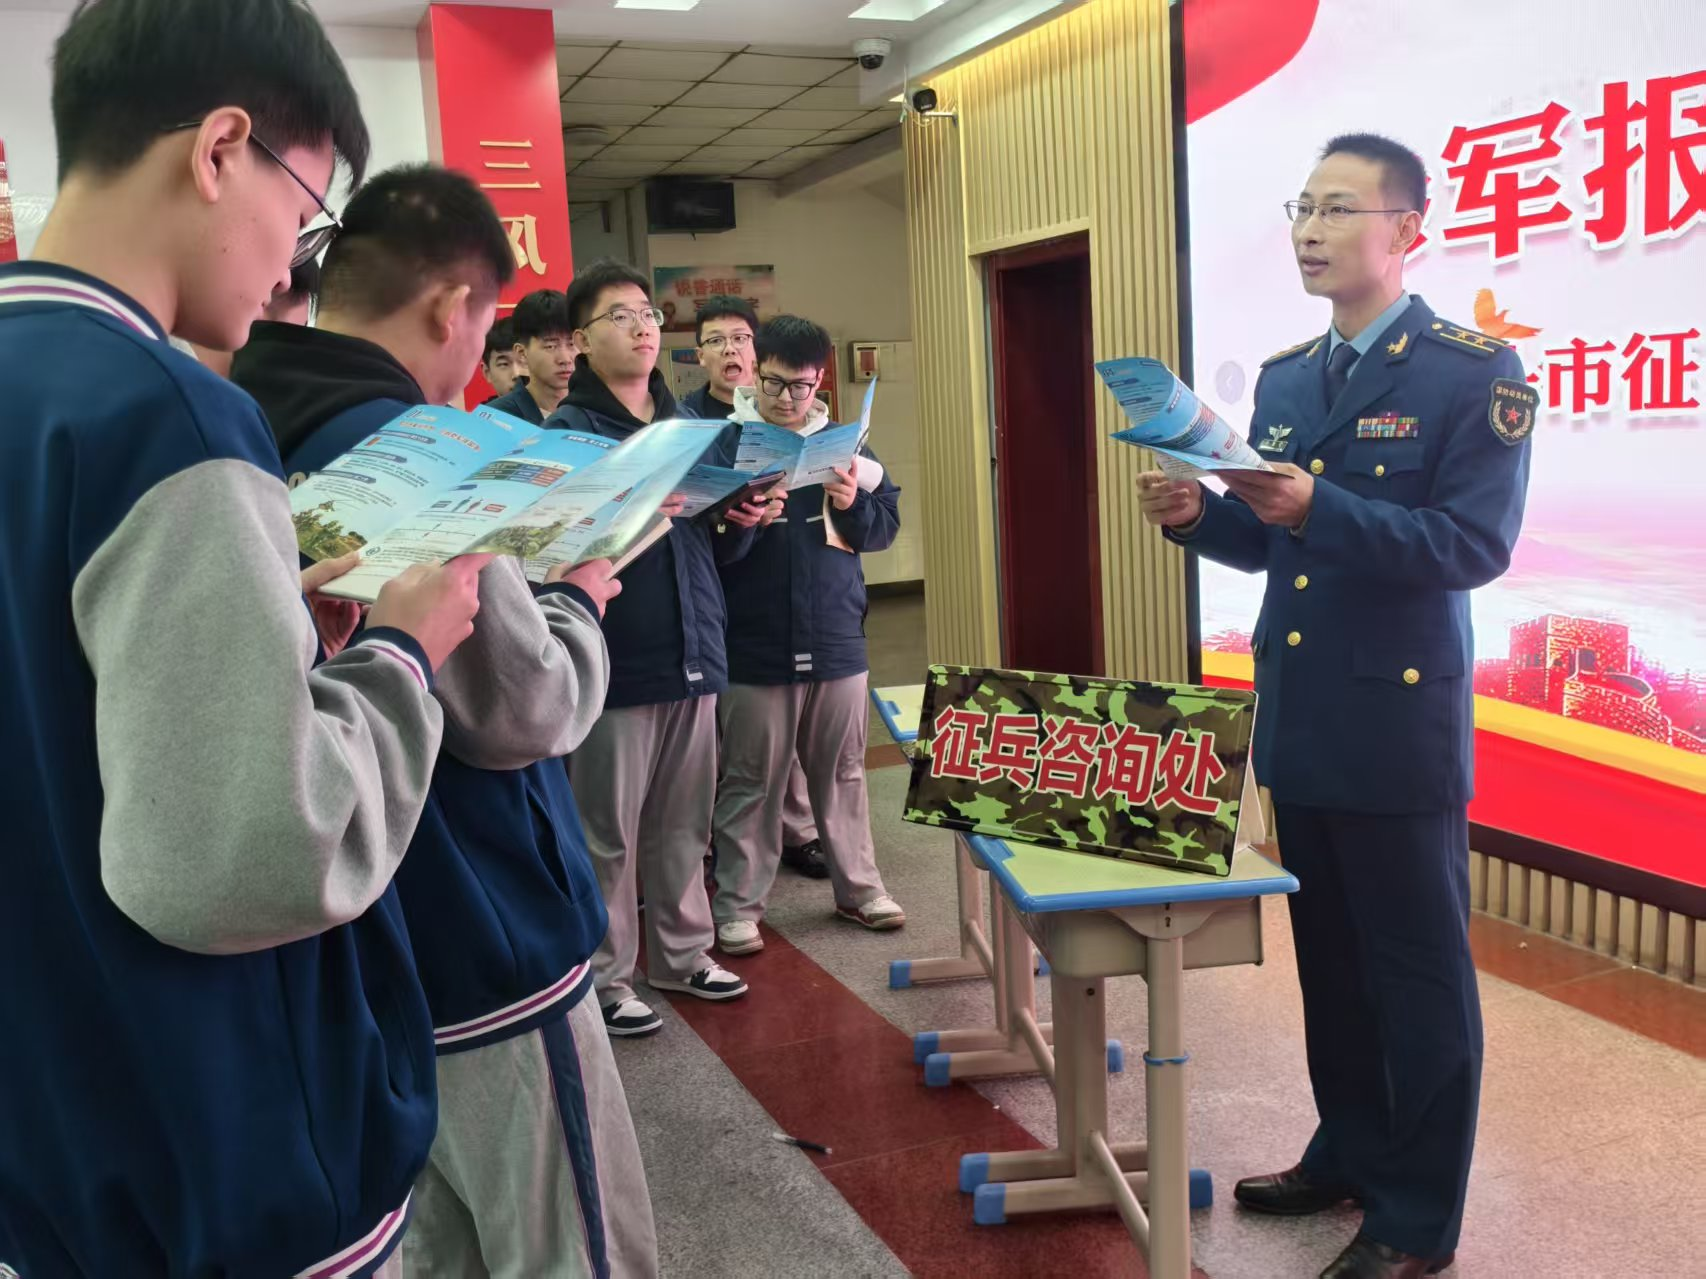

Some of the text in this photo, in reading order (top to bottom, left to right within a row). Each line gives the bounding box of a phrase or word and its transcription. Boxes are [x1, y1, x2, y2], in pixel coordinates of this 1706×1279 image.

[1407, 70, 1706, 258] 军报
[480, 139, 548, 308] 三风
[675, 279, 744, 297] 说普通话
[1526, 328, 1701, 413] 市征
[930, 704, 1227, 816] 征兵咨询处
